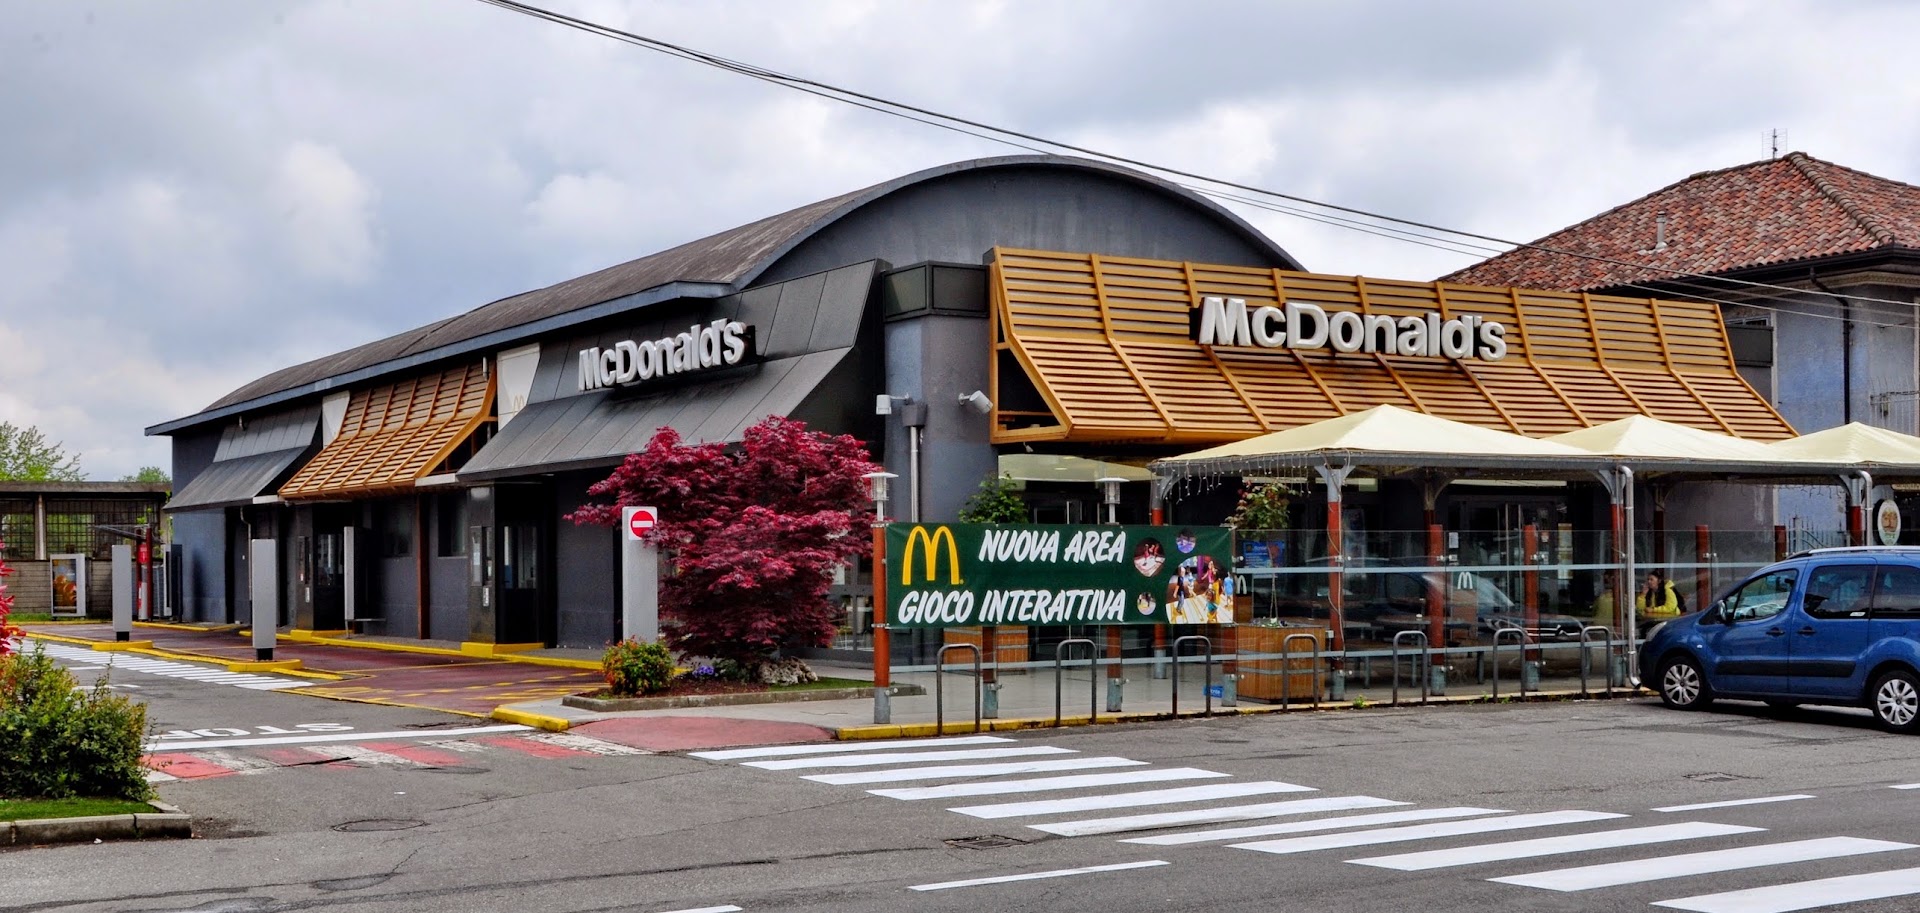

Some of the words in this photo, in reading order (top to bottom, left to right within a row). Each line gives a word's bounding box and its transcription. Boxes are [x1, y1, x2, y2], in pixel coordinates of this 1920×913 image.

[1198, 296, 1507, 361] McDonald's
[578, 318, 746, 391] McDonald's
[978, 529, 1060, 563] NUOVA
[1063, 530, 1126, 564] AREA
[898, 590, 974, 624] GIOCO
[978, 589, 1126, 624] INTERATTIVA
[150, 723, 354, 739] STOP
